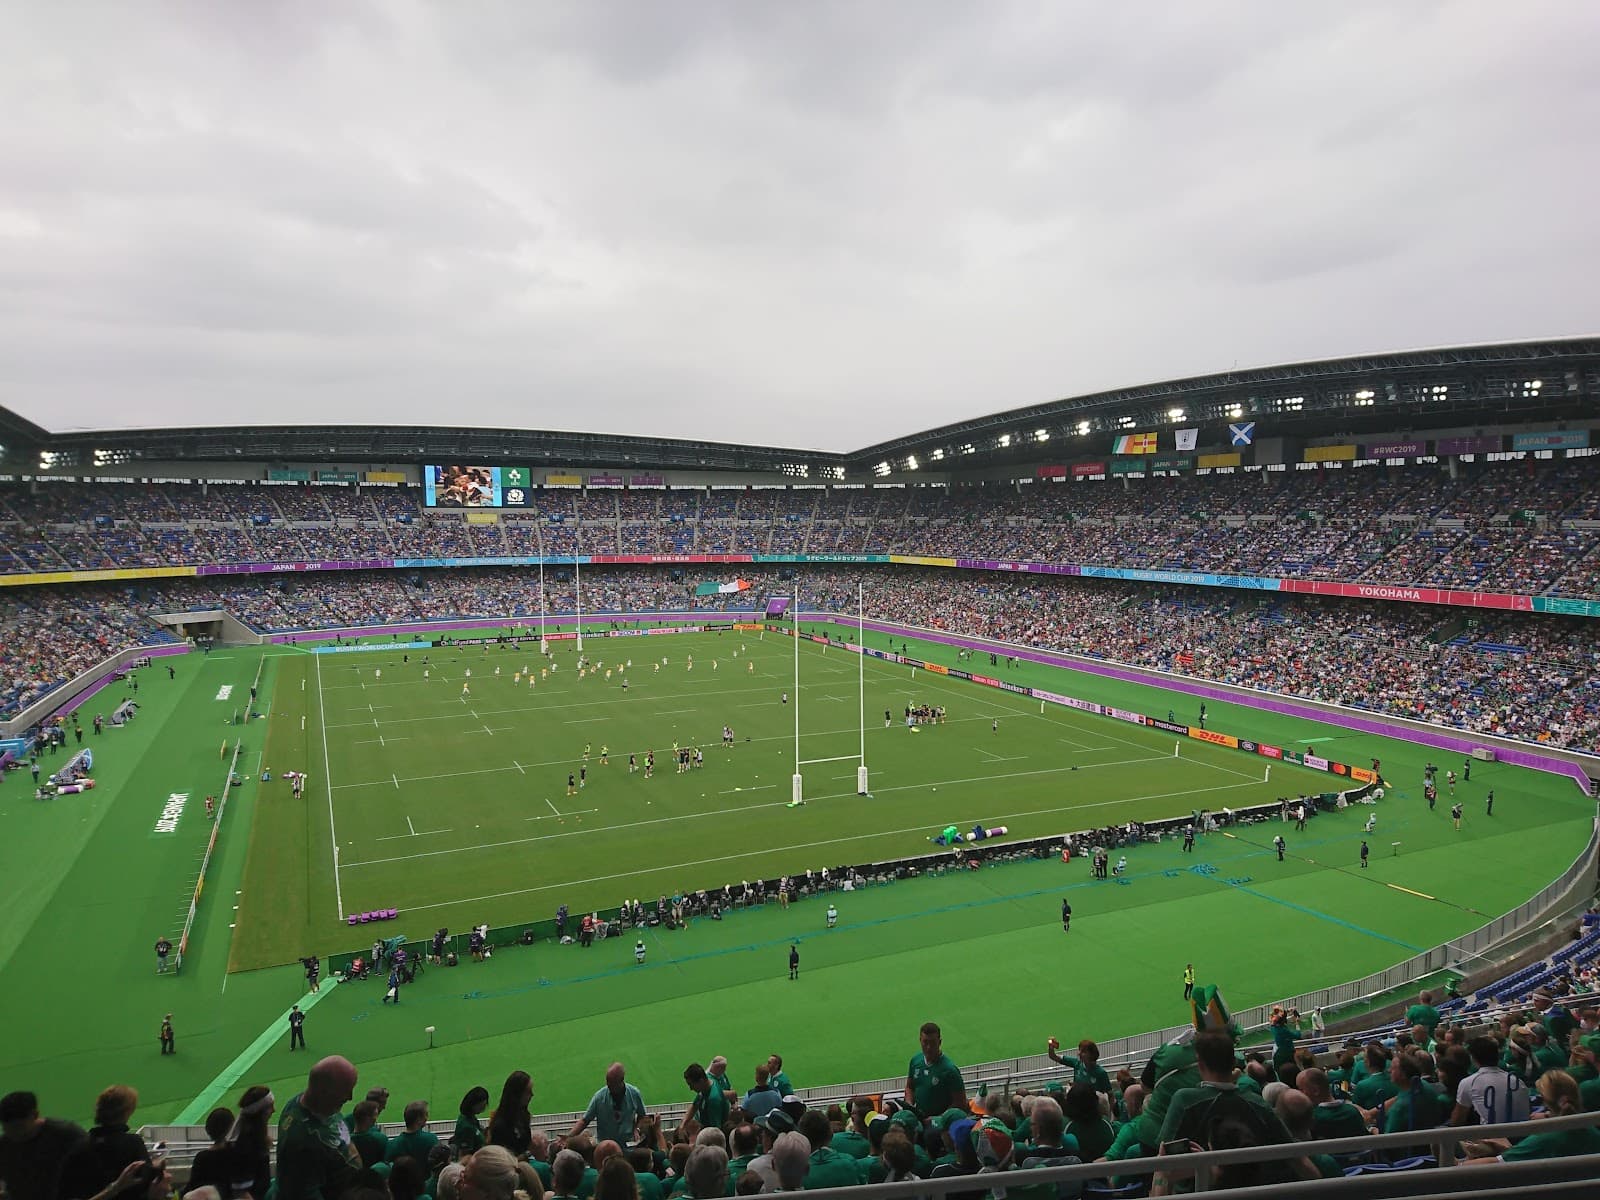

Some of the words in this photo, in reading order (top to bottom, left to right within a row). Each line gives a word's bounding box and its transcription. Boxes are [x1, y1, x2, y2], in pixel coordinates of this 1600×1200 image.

[1518, 437, 1548, 446] JAPAN
[1374, 445, 1417, 454] #RWC2019
[1133, 571, 1153, 579] RUGBY
[1154, 573, 1175, 581] WORLD
[1176, 574, 1190, 582] CUP
[1190, 575, 1205, 583] 2019
[1359, 586, 1421, 599] YOKOHAMA
[336, 643, 410, 652] RUGBYWORLDCUP.COM
[1155, 721, 1187, 734] mastercard
[1199, 731, 1226, 744] DHL
